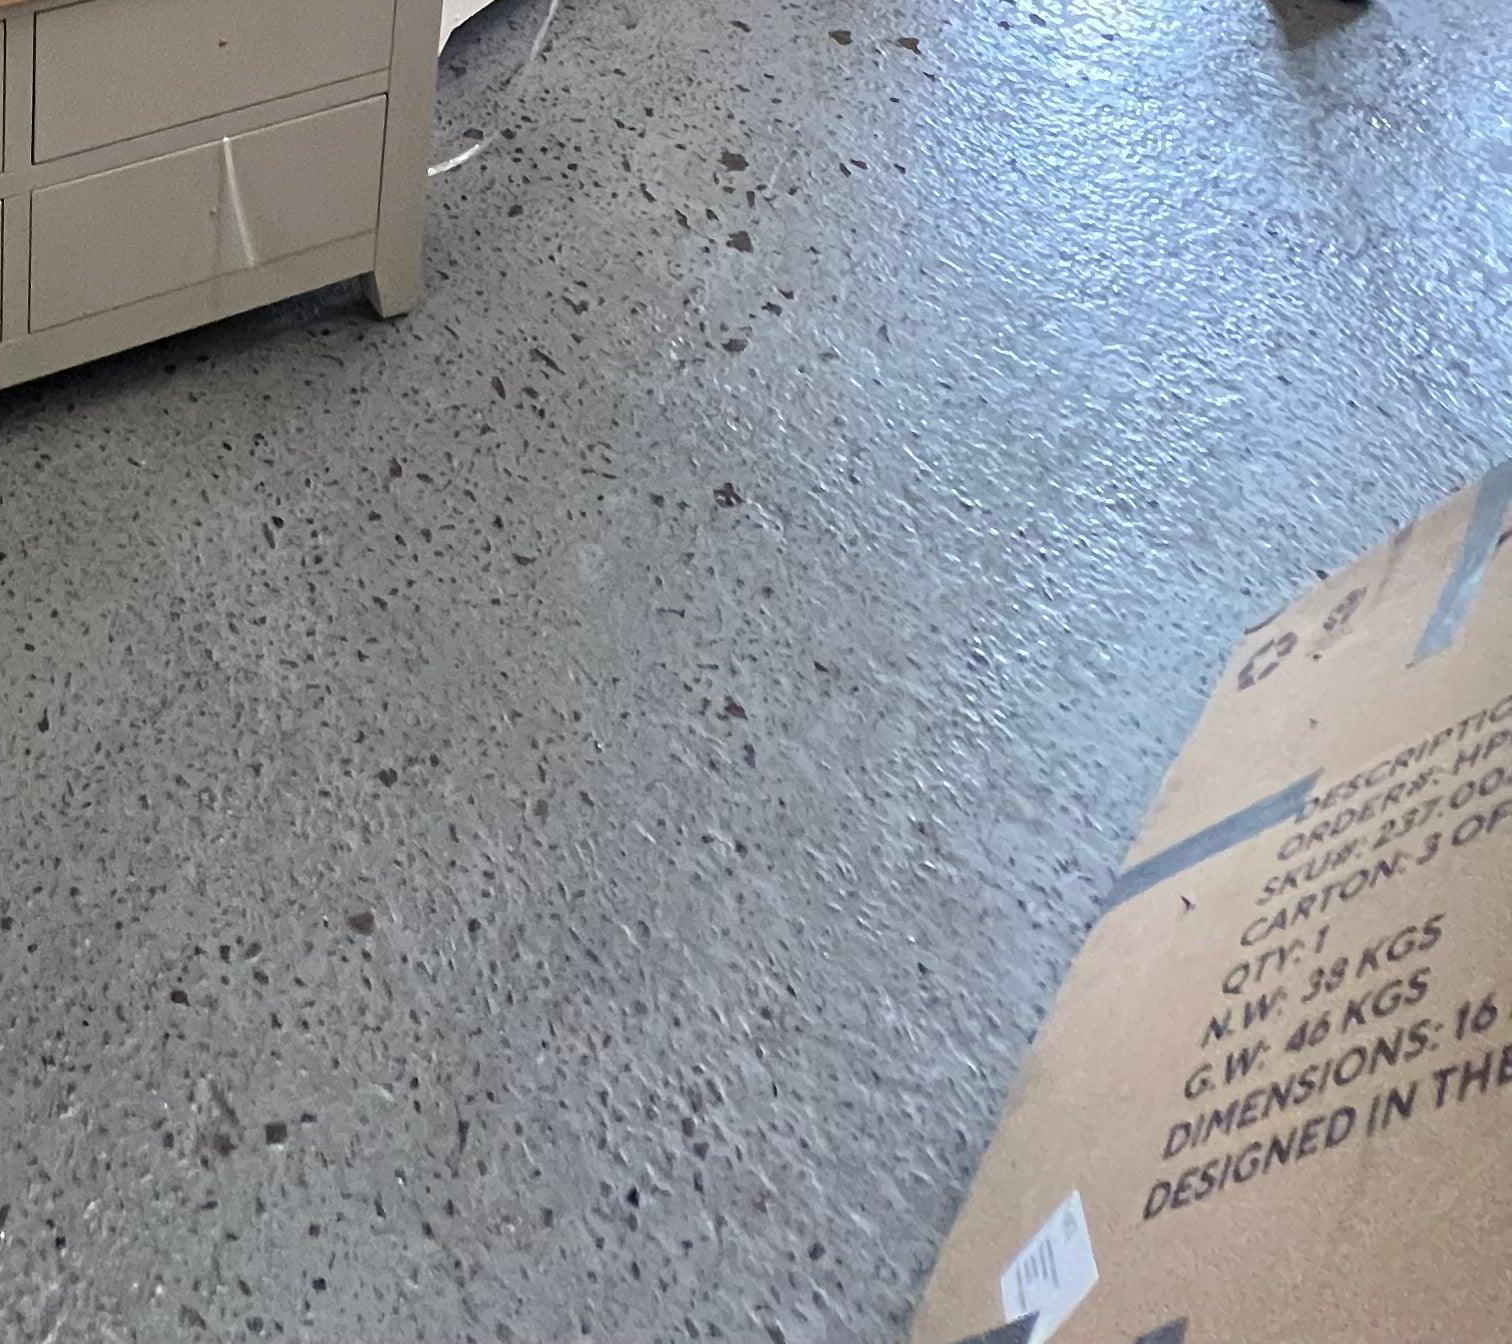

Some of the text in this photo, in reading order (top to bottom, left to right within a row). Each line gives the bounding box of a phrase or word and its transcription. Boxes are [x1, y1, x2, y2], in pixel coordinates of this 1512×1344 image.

[1453, 728, 1512, 775] HP
[1240, 850, 1412, 946] CARTON:
[1416, 832, 1443, 865] 3
[1222, 924, 1329, 994] QTY: 1
[1301, 957, 1348, 1002] 38
[1356, 913, 1445, 978] KGS
[1163, 992, 1498, 1160] DIMENSIONS: 16
[1185, 967, 1431, 1099] G.W: 46 KGS
[1143, 1043, 1512, 1221] DESIGNED IN THE
